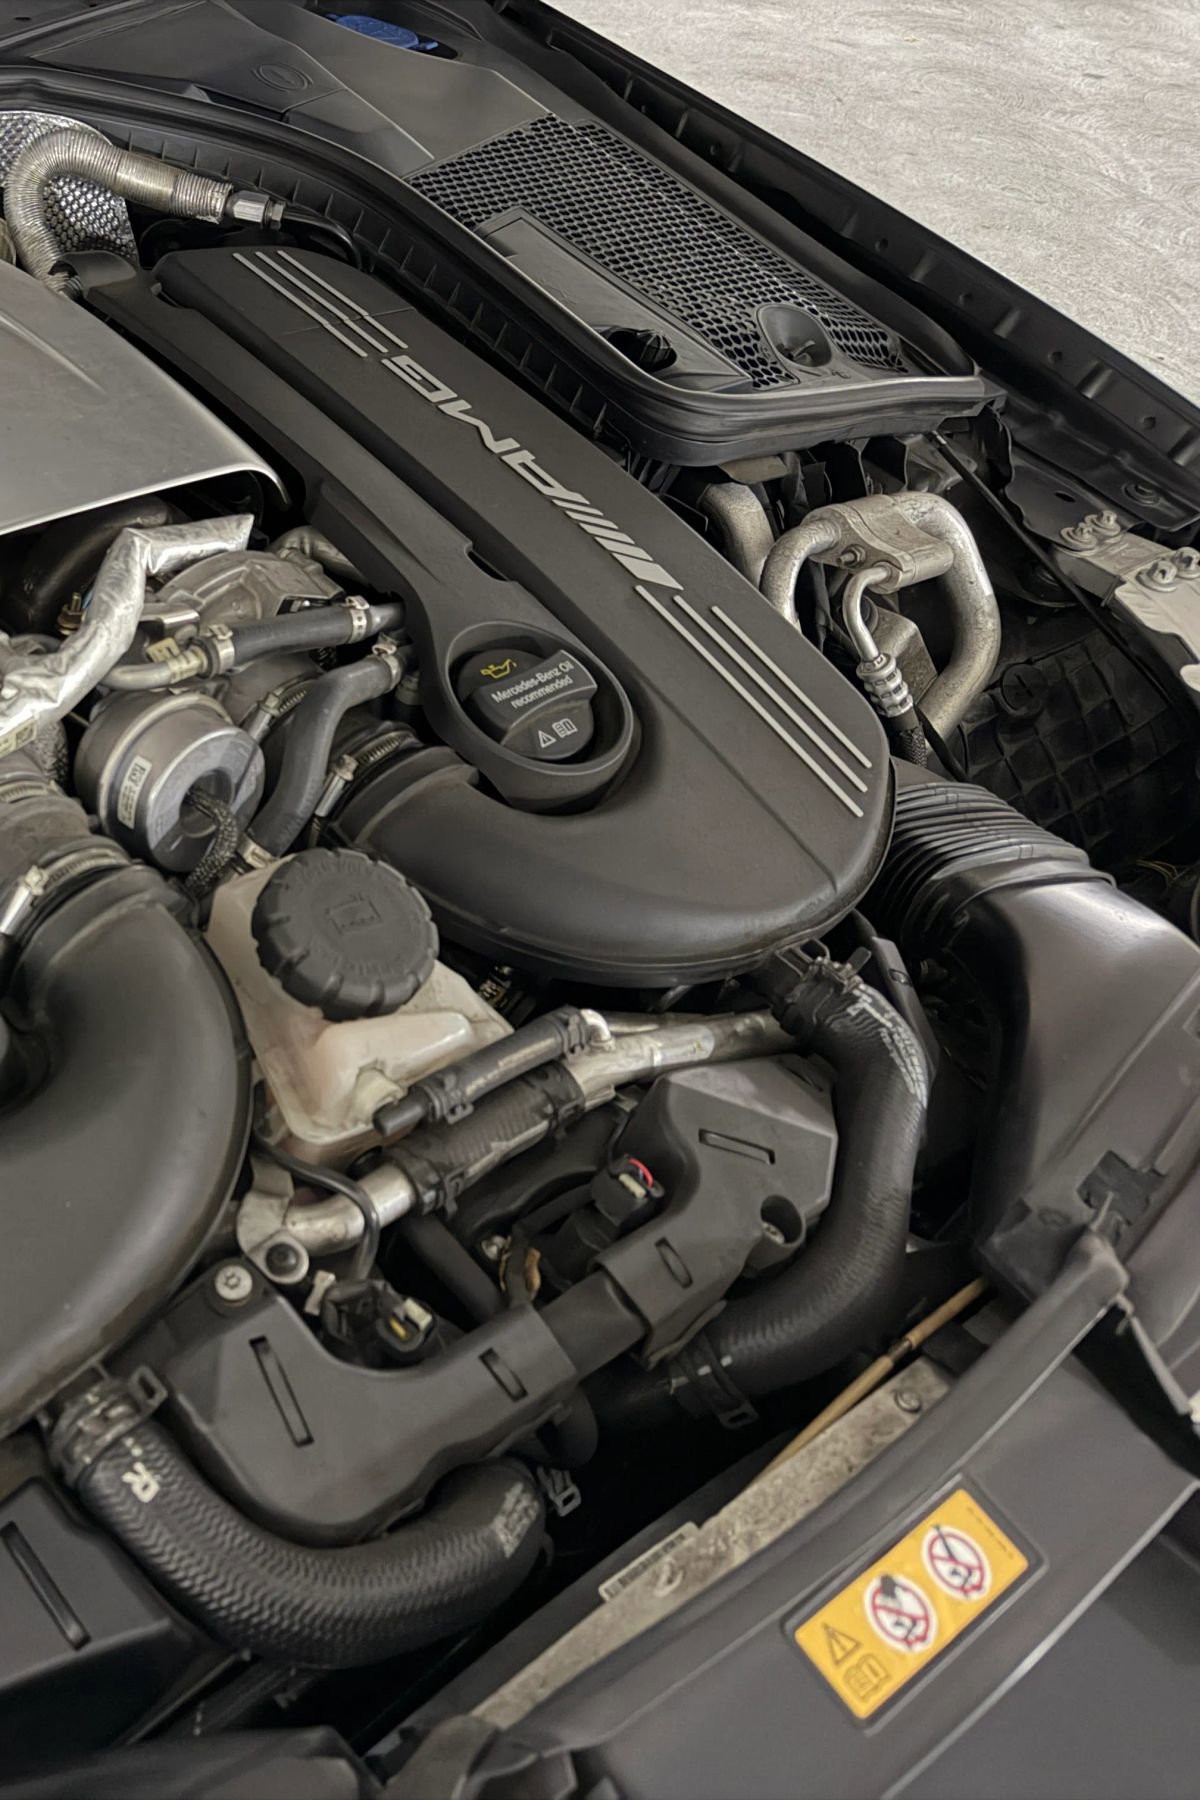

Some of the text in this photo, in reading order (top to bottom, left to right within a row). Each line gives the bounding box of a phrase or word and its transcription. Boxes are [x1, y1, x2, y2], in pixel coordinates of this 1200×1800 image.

[381, 355, 591, 505] AMG
[491, 660, 575, 703] Mercedes-Benz Oil
[511, 674, 574, 709] recommended
